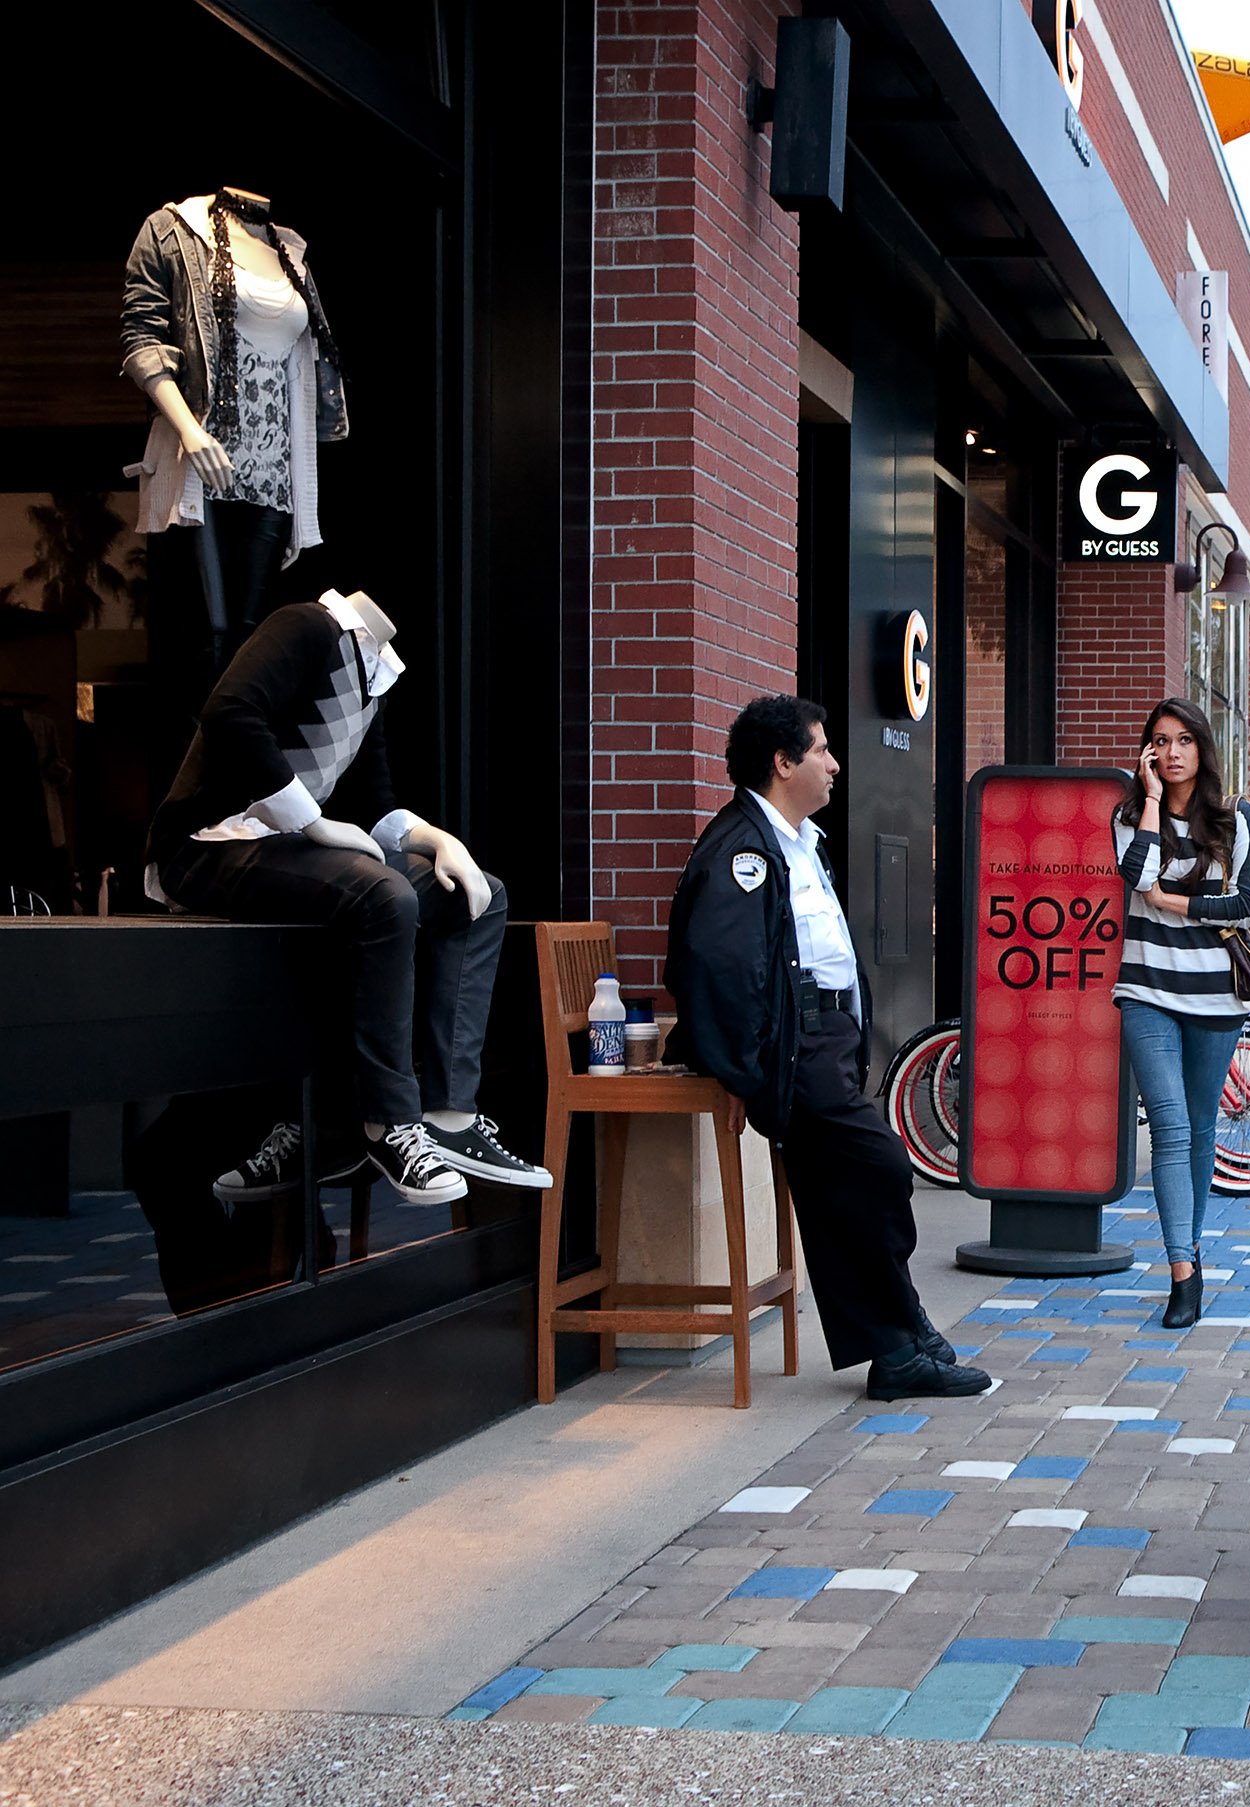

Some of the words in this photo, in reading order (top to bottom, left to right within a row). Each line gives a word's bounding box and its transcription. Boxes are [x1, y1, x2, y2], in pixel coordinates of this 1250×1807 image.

[1200, 276, 1211, 374] FORE
[1079, 454, 1158, 535] G
[1082, 540, 1103, 556] BY
[1105, 540, 1159, 556] GUESS
[904, 609, 930, 721] G
[989, 863, 1020, 874] TAKE
[1024, 863, 1041, 874] AN
[1044, 864, 1120, 876] ADDITIONAL
[986, 896, 1119, 942] 50%
[998, 946, 1106, 991] OFF
